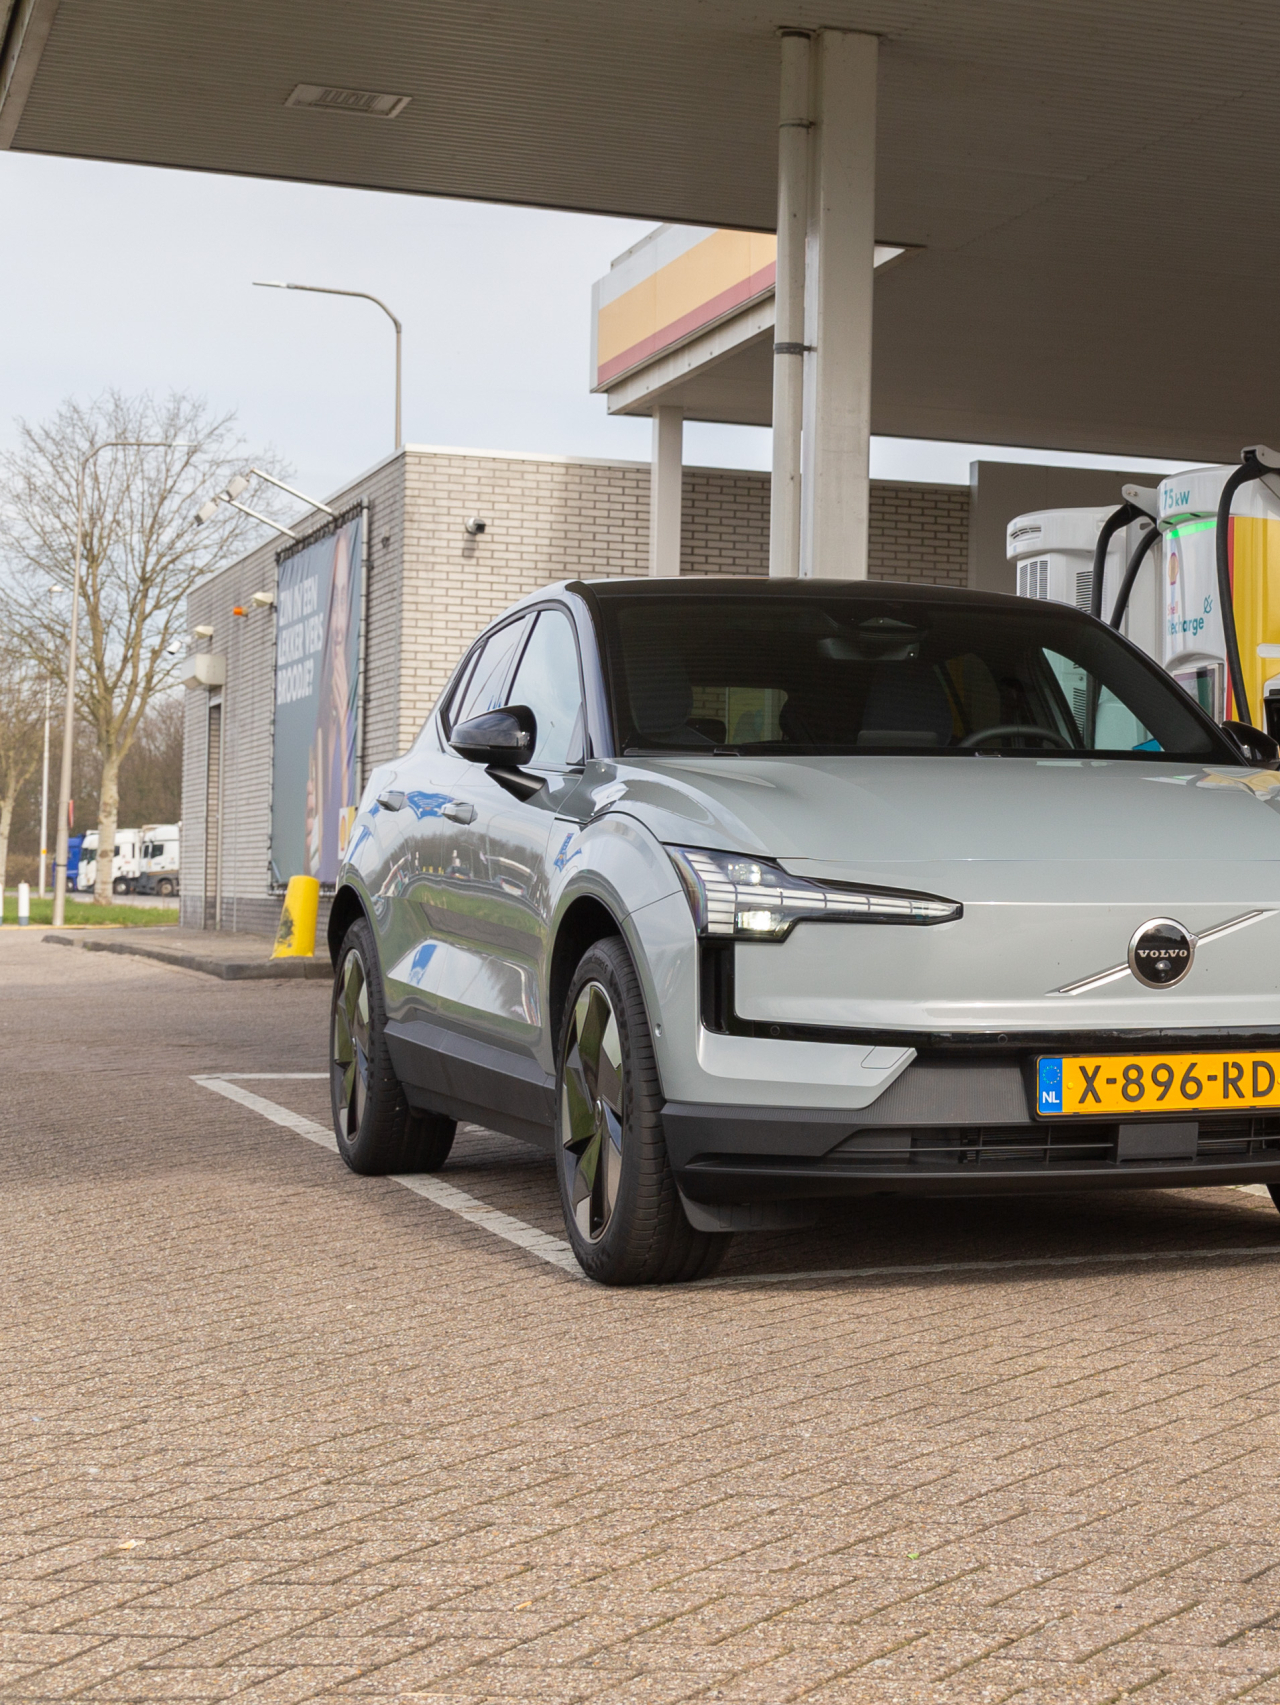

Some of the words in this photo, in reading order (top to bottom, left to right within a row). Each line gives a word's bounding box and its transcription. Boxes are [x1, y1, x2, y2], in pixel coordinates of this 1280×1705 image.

[302, 574, 319, 616] EEN
[304, 612, 324, 655] VERS
[1137, 949, 1188, 958] VOLVO
[1042, 1091, 1060, 1104] NL
[1078, 1060, 1276, 1104] X-896-RD
